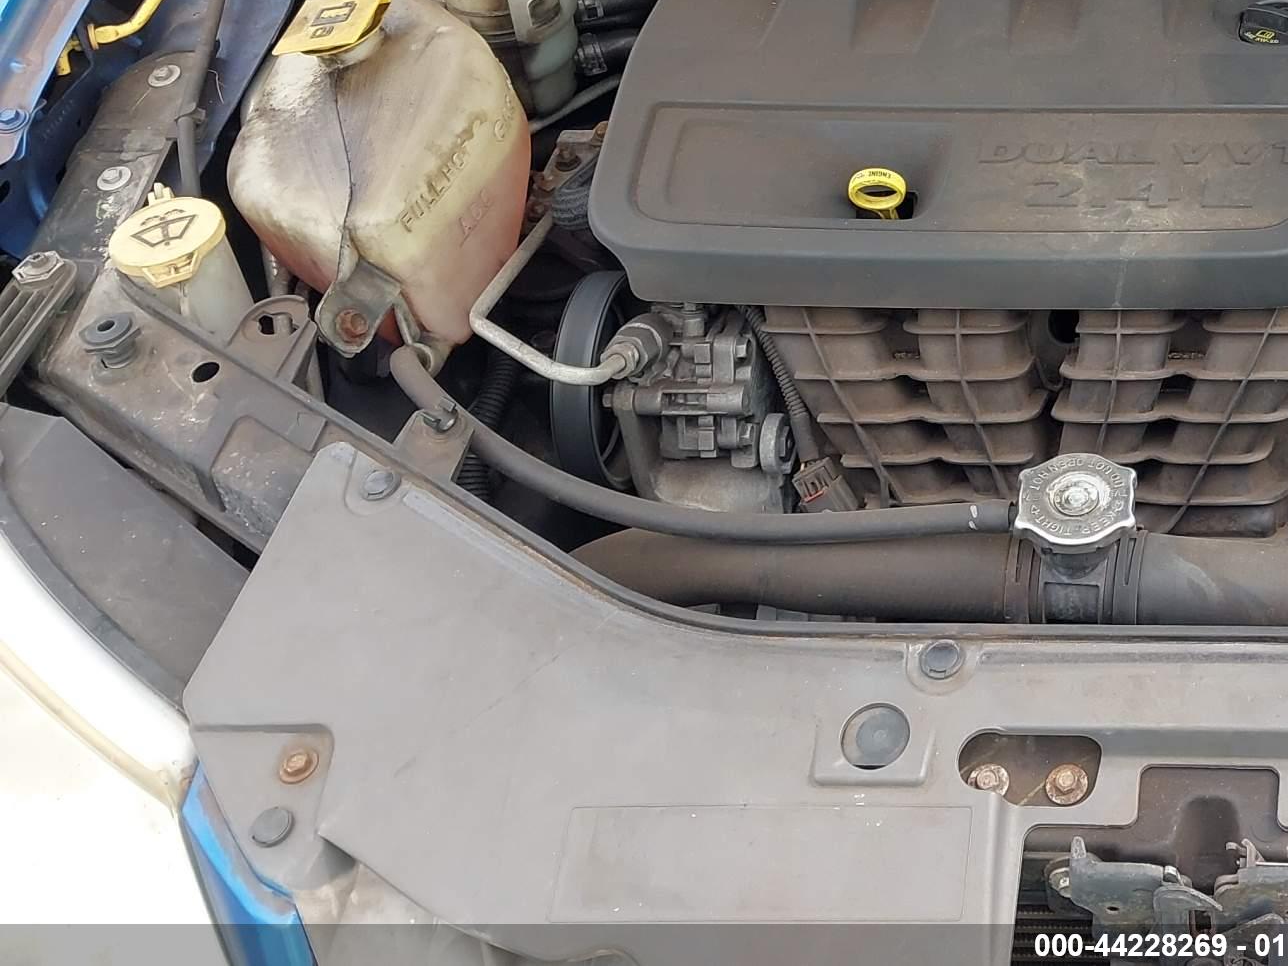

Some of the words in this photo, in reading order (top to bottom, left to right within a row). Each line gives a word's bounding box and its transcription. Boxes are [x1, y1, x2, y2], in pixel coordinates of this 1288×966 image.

[977, 141, 1159, 166] DUAL
[1047, 457, 1084, 473] OPEN
[1087, 459, 1113, 475] NOT
[1029, 471, 1049, 491] HOT
[1034, 515, 1073, 536] TIGHT
